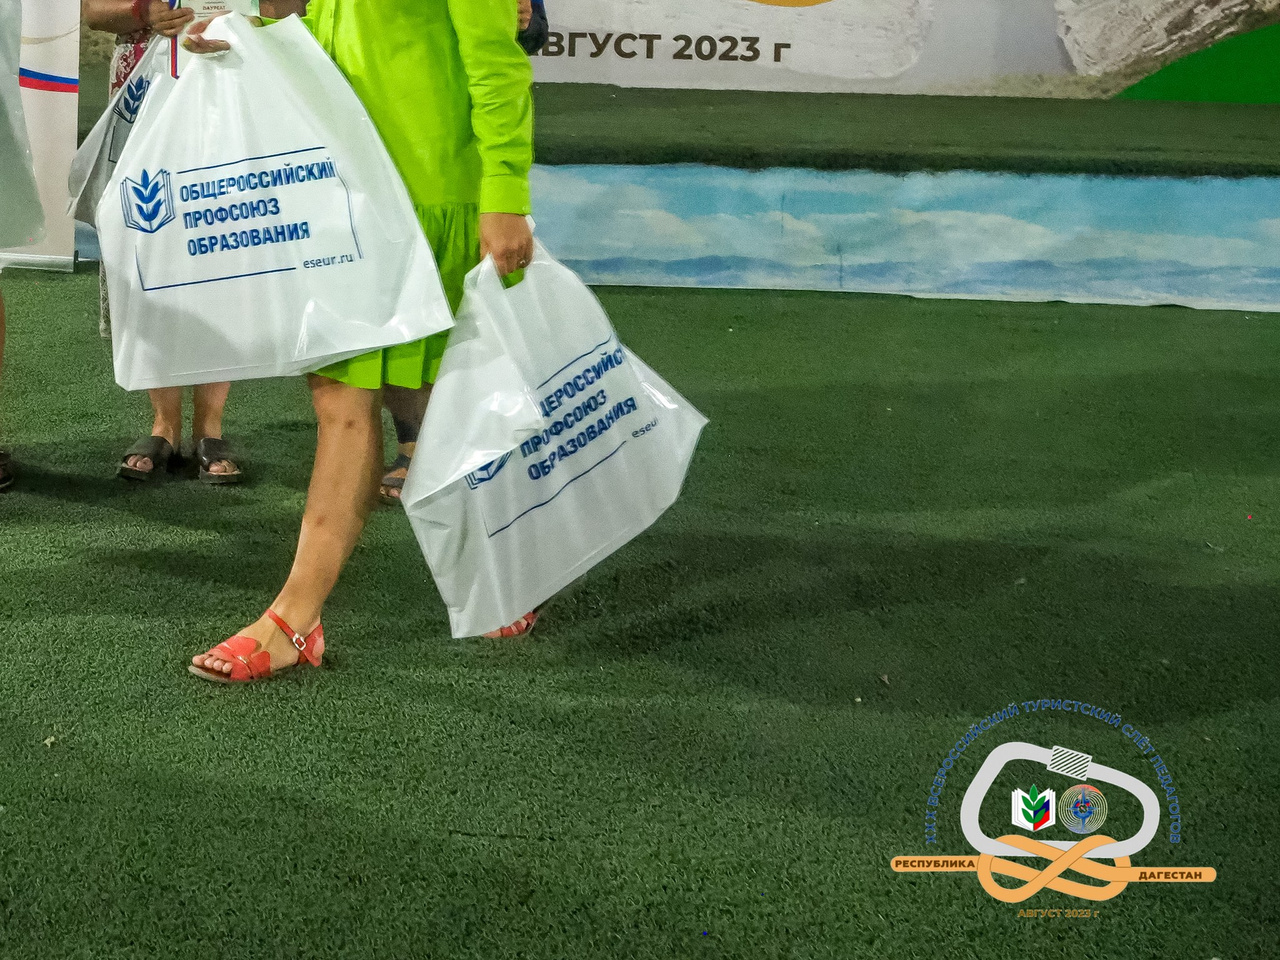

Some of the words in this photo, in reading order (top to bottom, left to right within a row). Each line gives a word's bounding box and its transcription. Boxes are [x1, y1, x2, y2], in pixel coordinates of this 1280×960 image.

[530, 31, 662, 59] ВГУСТ
[673, 34, 761, 62] 2023
[773, 42, 792, 62] г
[183, 197, 281, 230] ПРОФСОЮЗ
[187, 221, 311, 257] ОБРАЗОВАНИЯ
[303, 253, 354, 270] eseur.ru
[520, 389, 607, 458] ПРОФСОЮЗ
[527, 396, 638, 481] ОБРАЗОВАНИЯ
[631, 417, 659, 439] eseu
